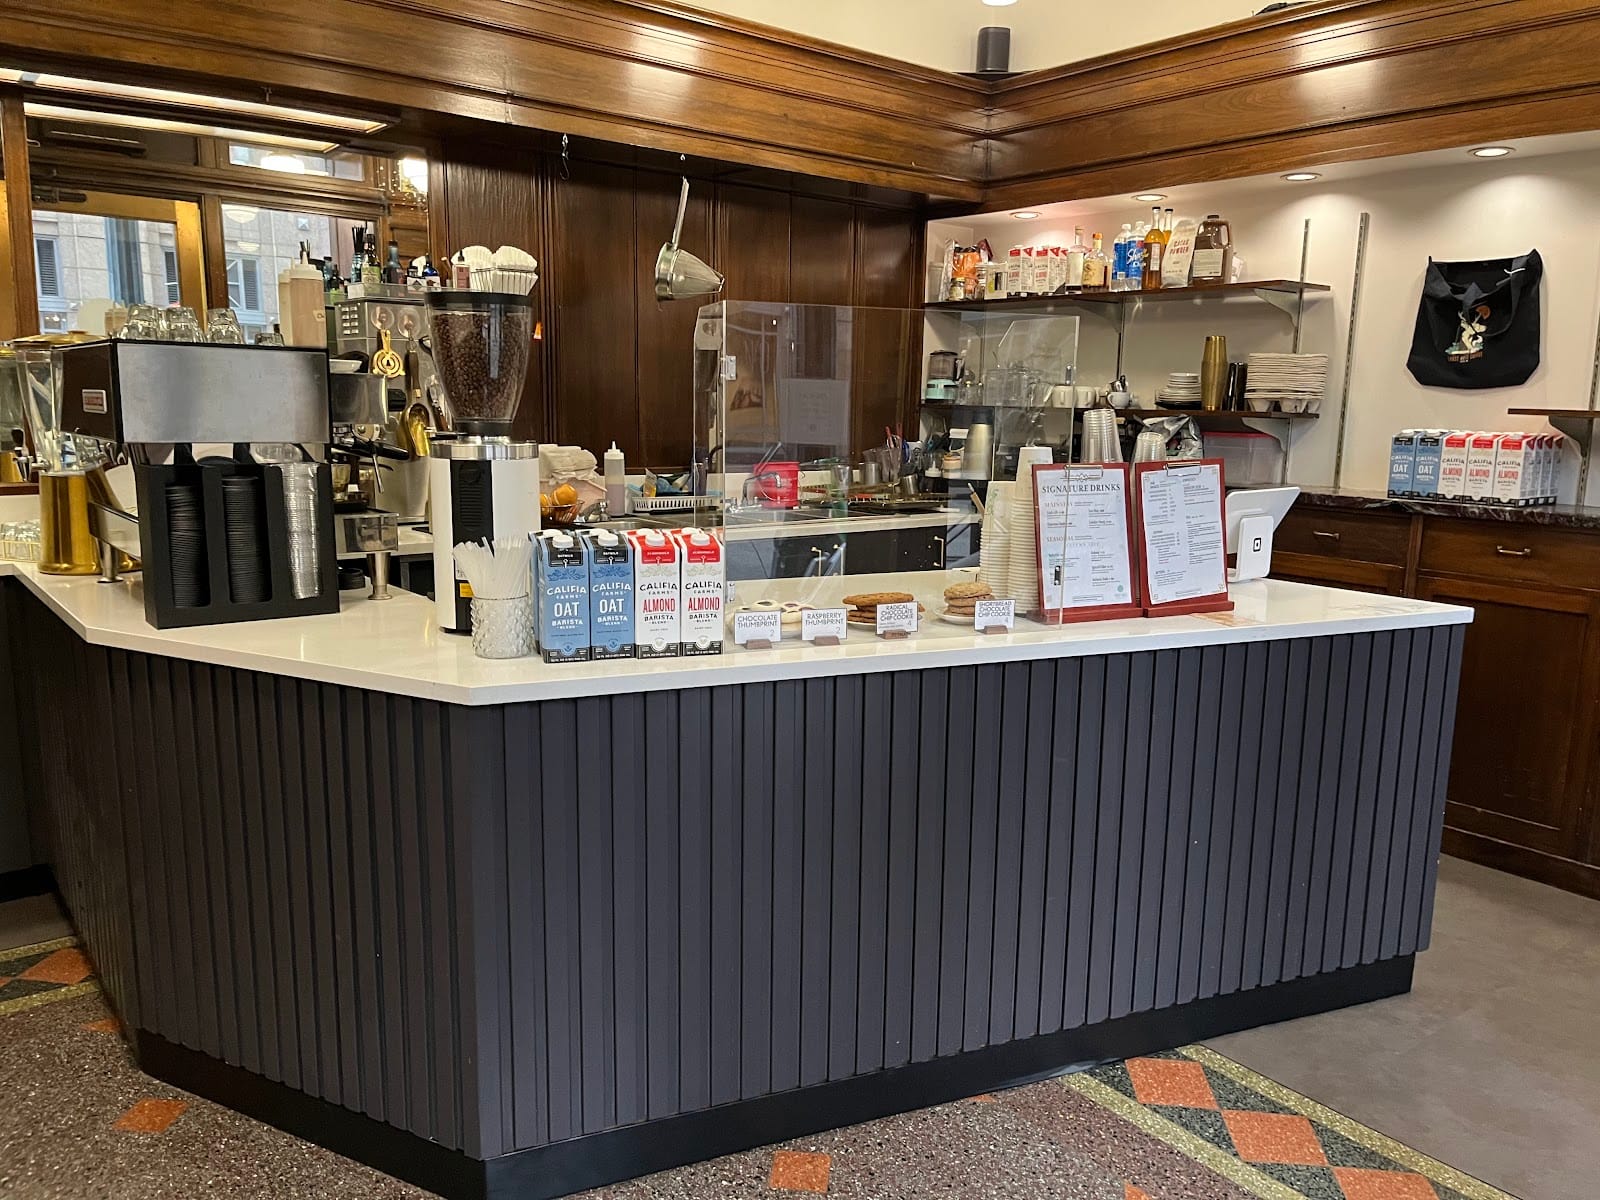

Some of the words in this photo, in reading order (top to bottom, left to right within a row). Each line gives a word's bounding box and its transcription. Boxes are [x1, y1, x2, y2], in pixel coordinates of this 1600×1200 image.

[1393, 464, 1408, 472] OAT
[1418, 465, 1433, 473] OAT
[1042, 485, 1088, 493] SIGNATURE
[1091, 484, 1120, 492] DRINKS
[547, 585, 586, 595] CALIFIA
[592, 582, 632, 592] CALIFIA
[640, 582, 677, 591] CALIFIA
[685, 581, 722, 590] CALIFIA
[599, 599, 624, 613] OAT
[643, 598, 676, 613] ALMOND
[688, 597, 720, 611] ALMOND
[554, 602, 579, 617] OAT
[881, 608, 913, 616] CHOCOLATE
[597, 615, 628, 623] BARISTA
[644, 614, 674, 622] BARISTA
[737, 614, 778, 622] CHOCOLATE
[737, 620, 778, 628] THUMBPRINT
[769, 629, 775, 637] 2
